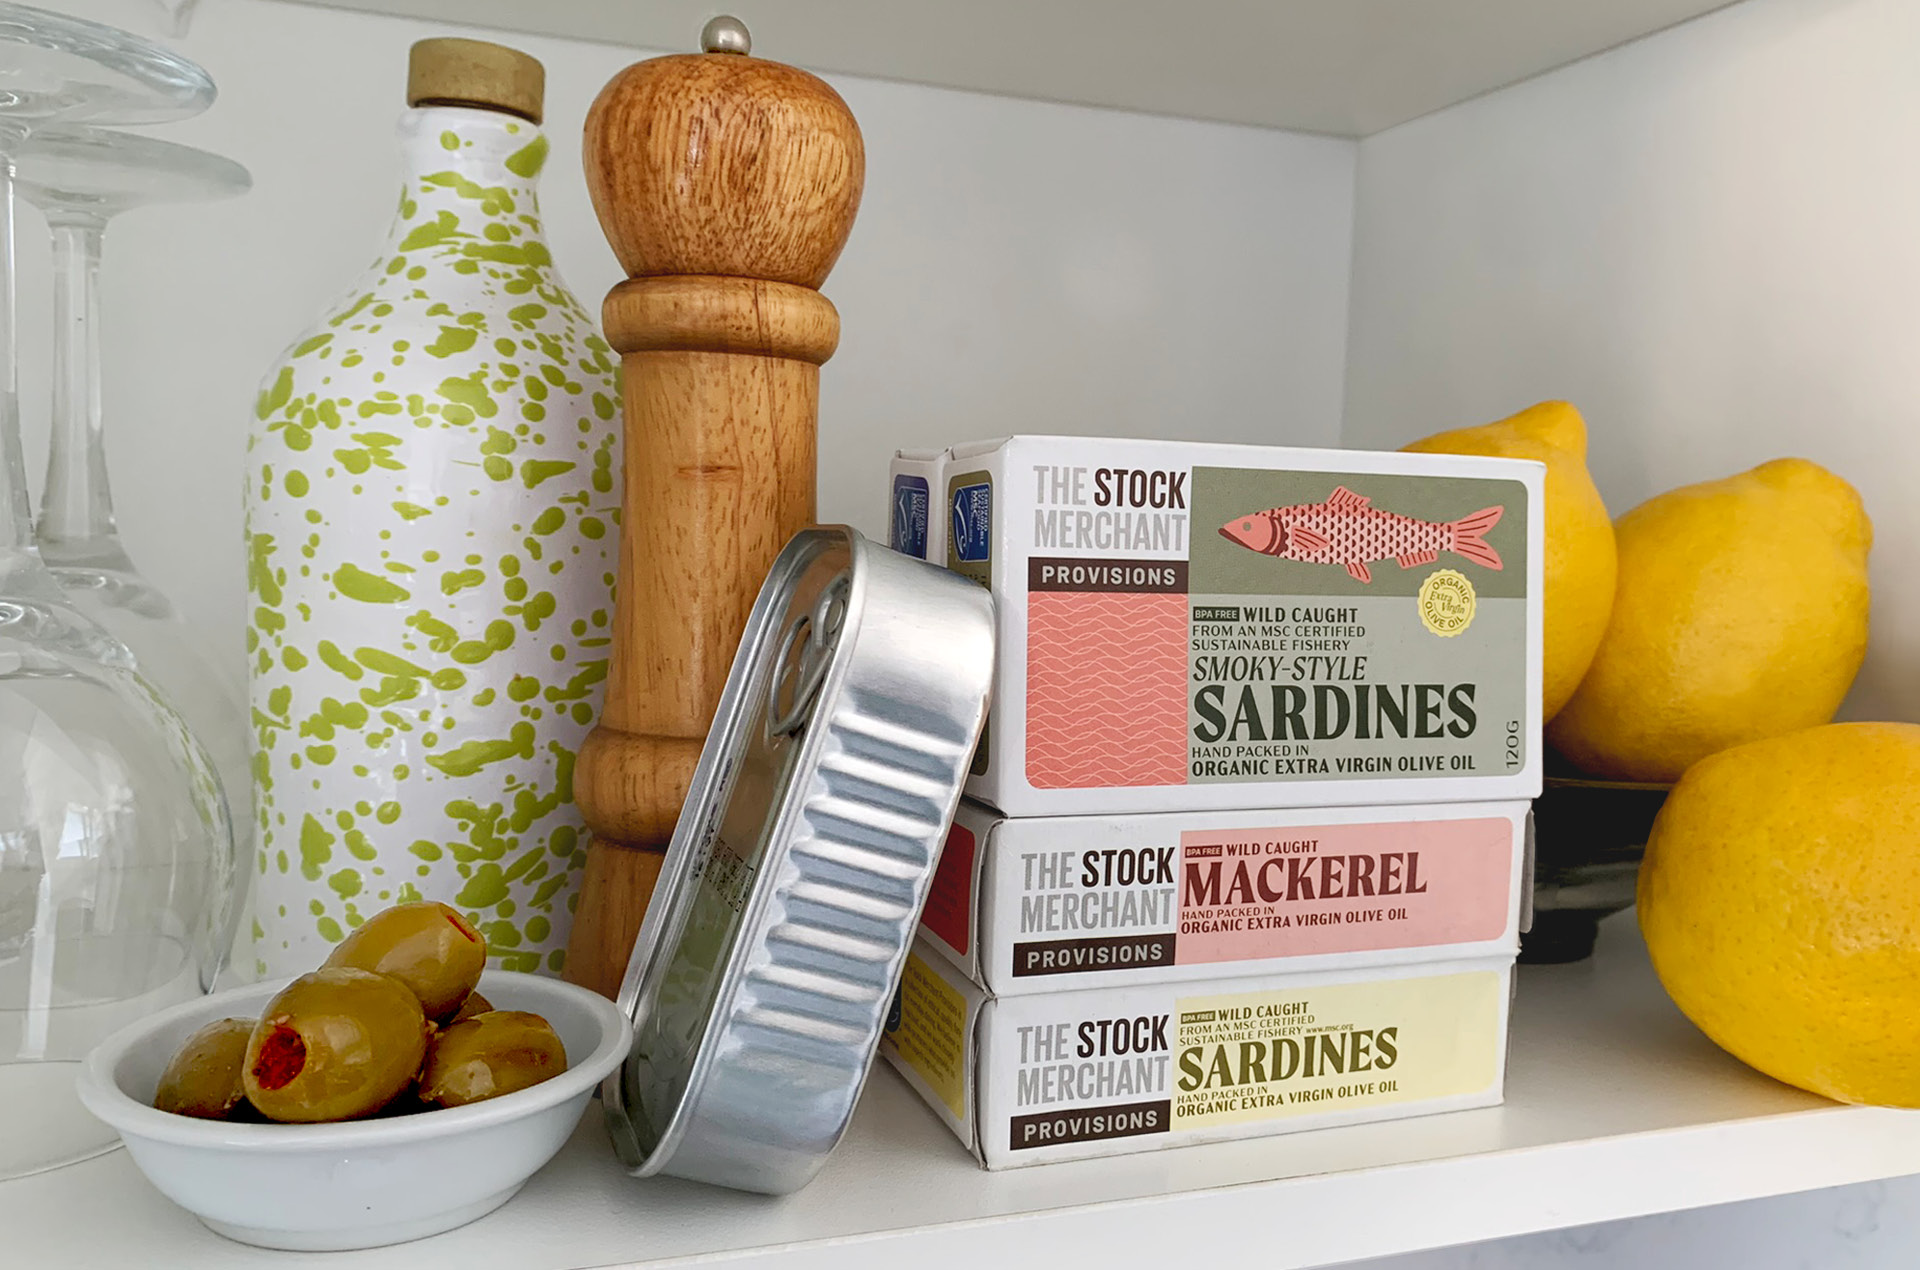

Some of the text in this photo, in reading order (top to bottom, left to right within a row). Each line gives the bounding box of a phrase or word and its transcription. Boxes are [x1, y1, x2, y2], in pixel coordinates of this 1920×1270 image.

[1033, 465, 1187, 509] THE STOCK
[1034, 509, 1187, 551] MERCHANT
[1042, 565, 1176, 586] PROVISIONS
[1430, 591, 1453, 602] Extra
[1432, 577, 1470, 604] ORGANIC
[1195, 607, 1358, 623] BPA FREE WILD CAUGHT
[1425, 601, 1464, 628] OLIVE OIL
[1442, 601, 1465, 614] Virgin
[1192, 625, 1366, 637] FROM AN MSC CERTIFIED
[1192, 639, 1351, 651] SUSTAINABLE FISHERY
[1192, 655, 1368, 682] SMOKY-STYLE
[1193, 683, 1477, 743] SARDINES
[1192, 745, 1309, 758] HAND PACKED IN
[1506, 720, 1520, 769] 120G
[1192, 755, 1476, 777] ORGANIC EXTRA VIRGIN OLIVE OIL
[1186, 840, 1319, 857] BPA FREE WILD CAUGHT
[1021, 847, 1175, 891] THE STOCK
[1183, 852, 1428, 907] MACKEREL
[1020, 888, 1175, 933] MERCHANT
[1181, 908, 1408, 935] ORGANIC EXTRA VIRGIN OLIVE OIL
[1182, 906, 1275, 921] HAND PACKED IN
[1027, 943, 1162, 969] PROVISIONS
[1180, 1015, 1315, 1036] FROM AN MSC CERTIFIED
[1197, 1013, 1215, 1022] FREE
[1218, 1007, 1251, 1021] WILD
[1256, 1002, 1309, 1018] CAUGHT
[1017, 1014, 1169, 1064] THE STOCK
[1179, 1023, 1354, 1046] SUSTAINABLE FISHERY www.msc.org
[1178, 1027, 1398, 1092] SARDINES
[1017, 1055, 1170, 1107] MERCHANT
[1177, 1086, 1268, 1104] HAND PACKED IN
[1177, 1080, 1398, 1117] ORGANIC EXTRA VIRGIN OLIVE OIL
[1024, 1110, 1157, 1142] PROVISIONS
